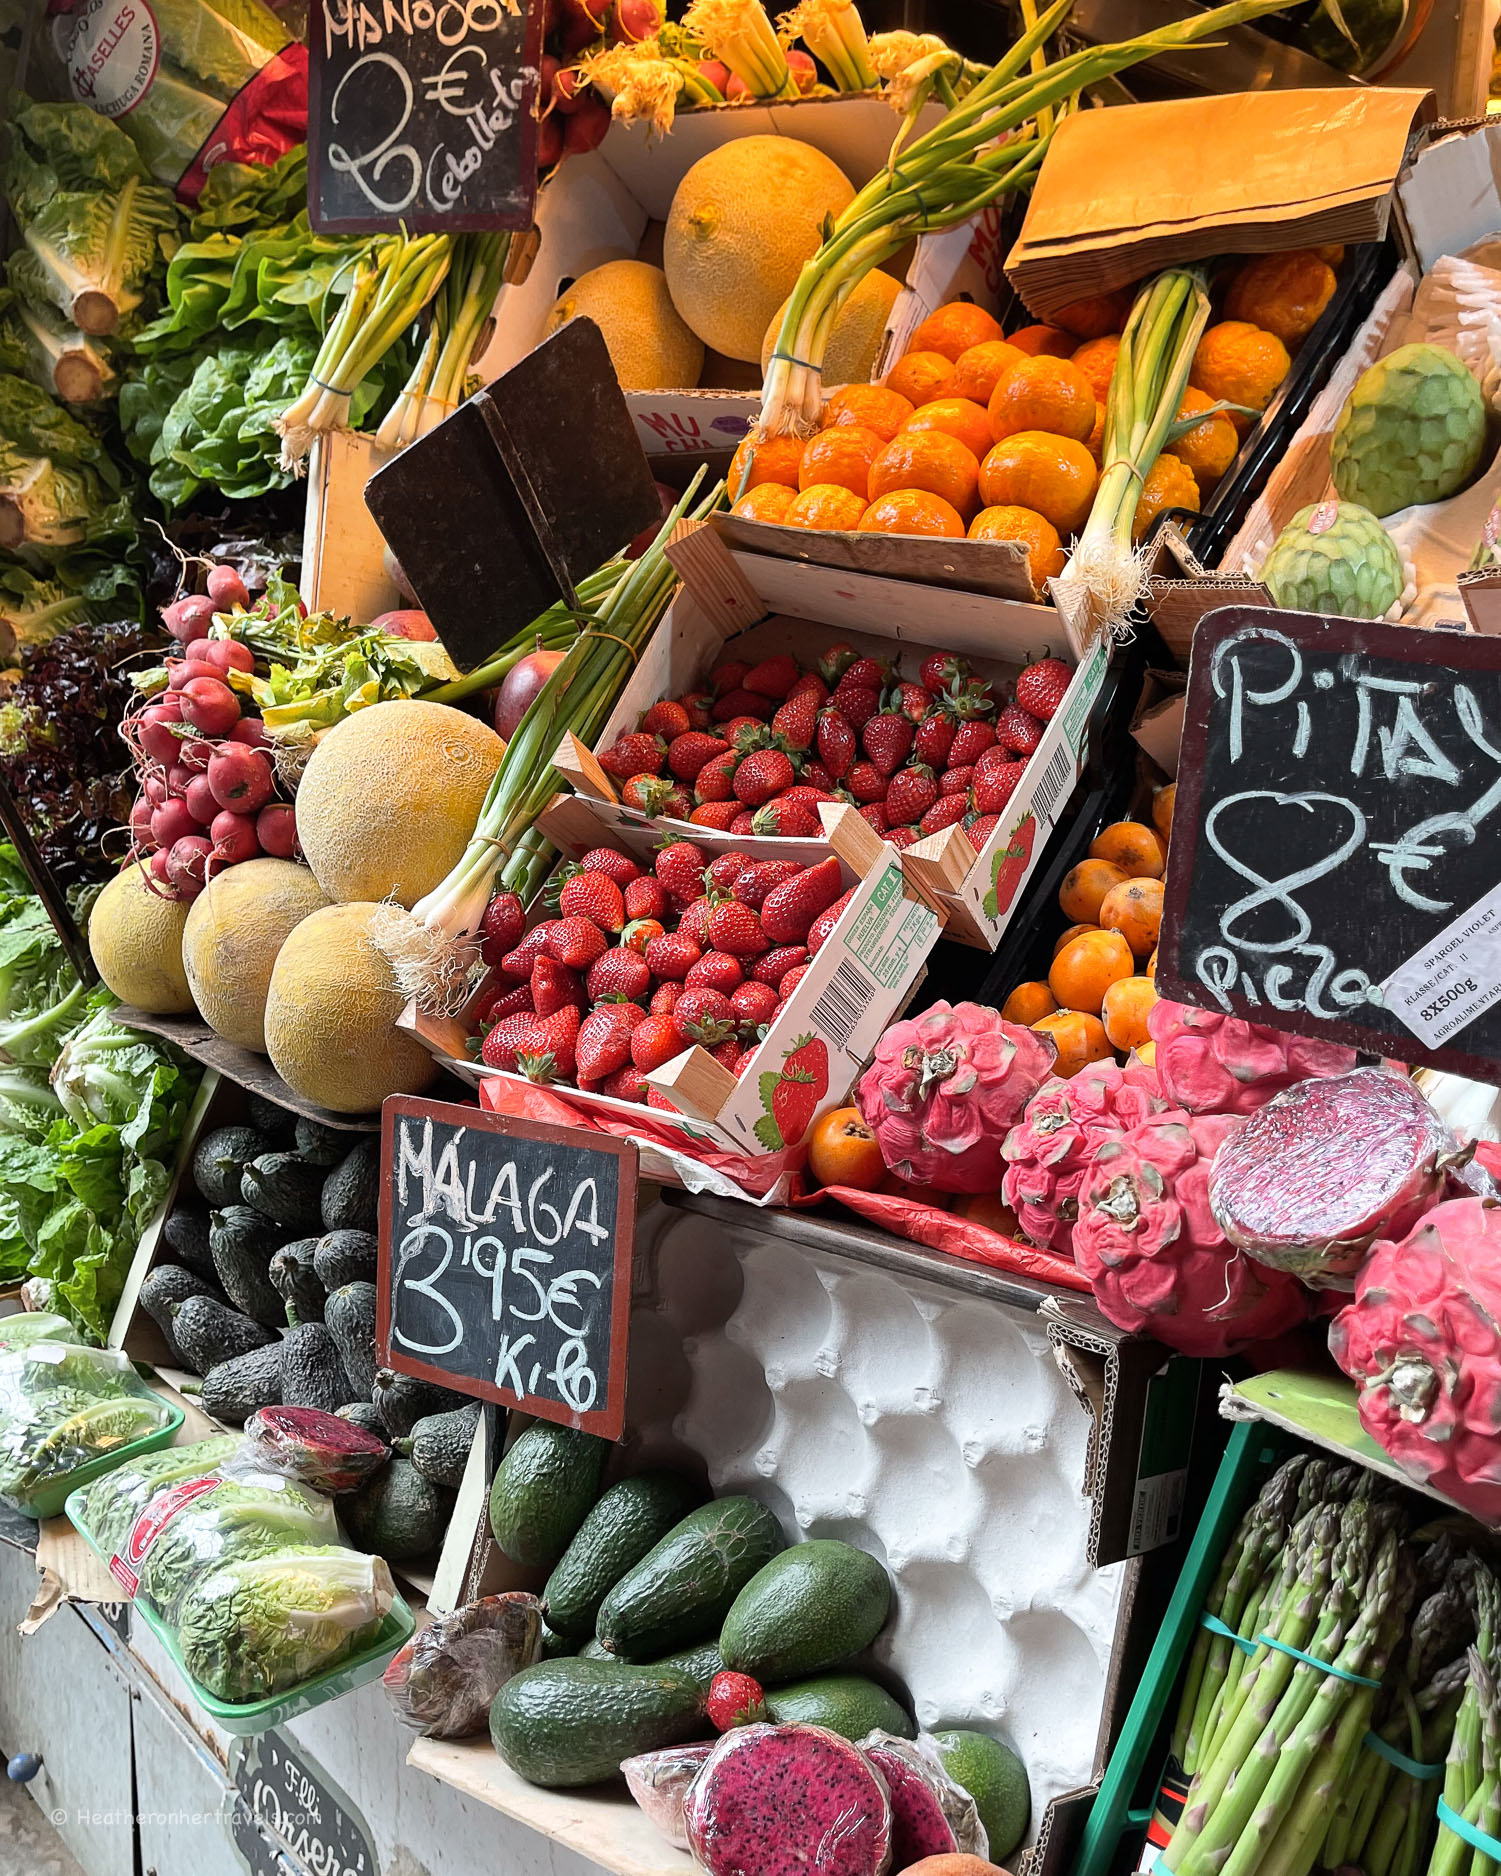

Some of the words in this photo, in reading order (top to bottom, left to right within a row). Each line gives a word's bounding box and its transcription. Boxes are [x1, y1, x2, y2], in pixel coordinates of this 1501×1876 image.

[135, 24, 153, 86] ROMANA
[637, 412, 700, 438] MU
[876, 882, 892, 902] CAT.
[855, 914, 874, 942] HUELVA
[862, 918, 890, 960] STRAWBERRIES
[872, 902, 892, 933] FRESONES
[1423, 937, 1464, 970] SPARGEL
[1462, 909, 1496, 937] VIOLET
[840, 1021, 858, 1047] 400065
[857, 991, 875, 1019] 033500
[1420, 977, 1478, 1021] 8X500g
[395, 1116, 609, 1246] MÁLAGA
